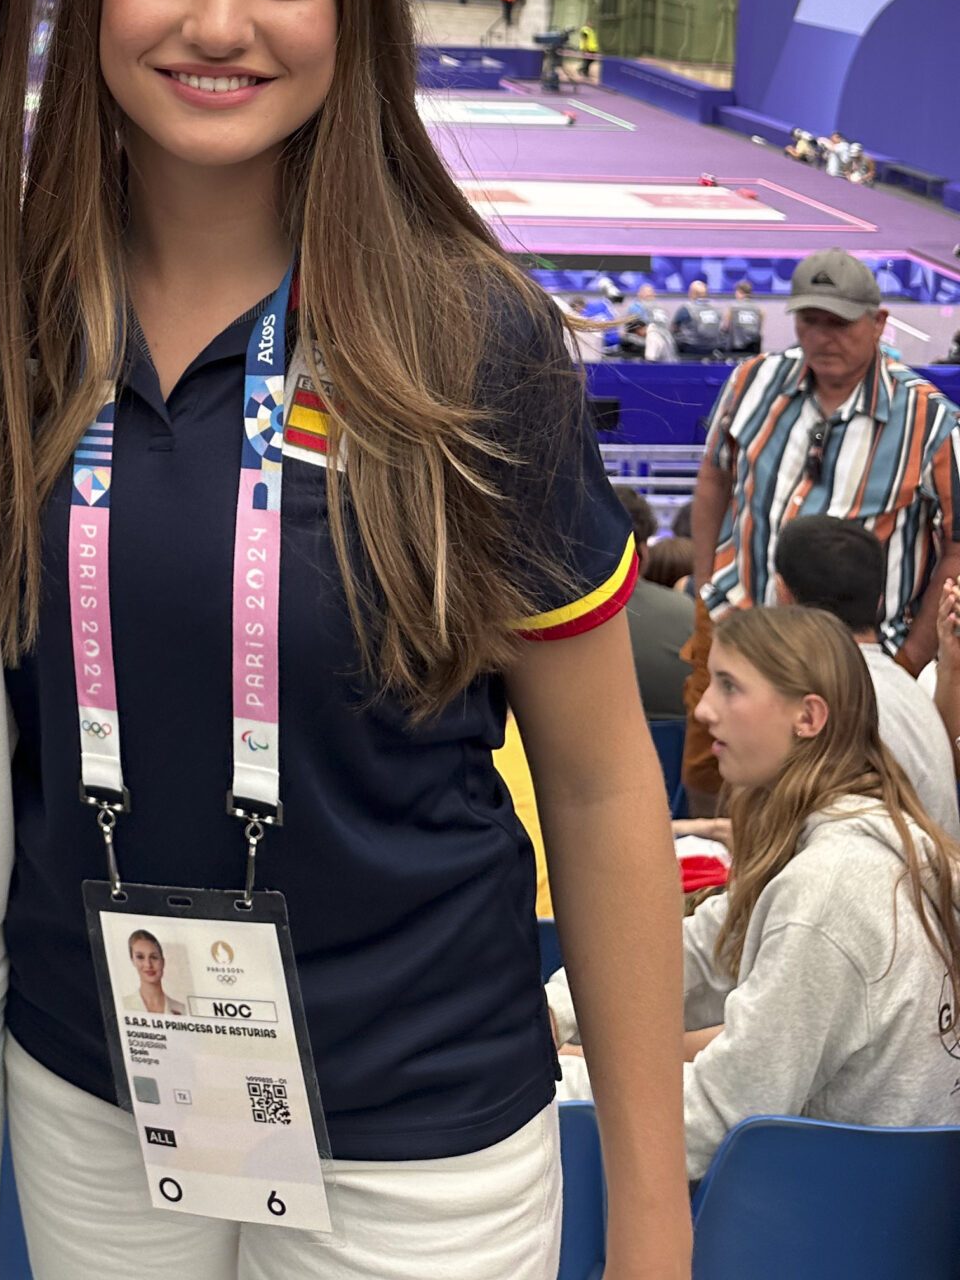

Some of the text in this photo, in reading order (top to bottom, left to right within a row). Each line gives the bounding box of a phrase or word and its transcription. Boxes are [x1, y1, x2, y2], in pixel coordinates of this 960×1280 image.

[257, 313, 276, 365] Atos
[245, 527, 267, 610] 2024
[81, 621, 102, 695] 2024
[213, 1002, 252, 1019] NOC
[124, 1016, 277, 1039] S.A.R. LA PRINCESA DE ASTURIAS
[149, 1132, 174, 1145] ALL
[267, 1190, 286, 1216] 6
